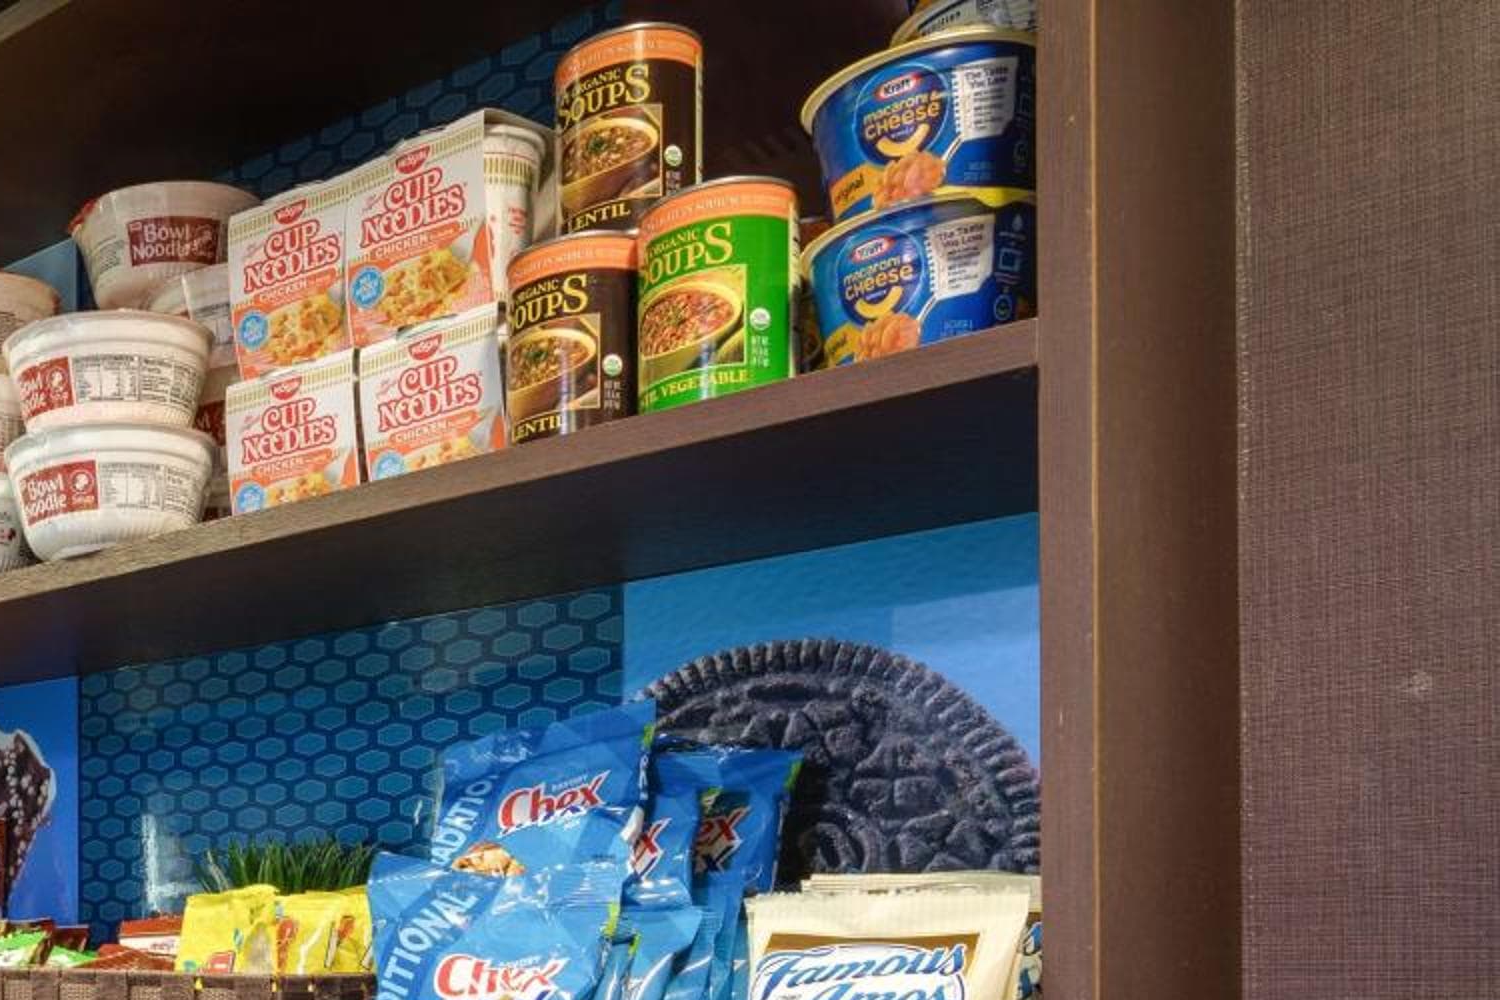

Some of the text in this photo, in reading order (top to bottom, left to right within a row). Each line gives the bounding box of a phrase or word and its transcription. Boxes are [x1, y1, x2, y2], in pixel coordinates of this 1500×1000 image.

[559, 63, 651, 131] SOUPS
[884, 78, 911, 95] Kraft
[863, 94, 929, 126] macaroni
[384, 167, 443, 211] CUP
[143, 223, 191, 243] Bowl
[360, 184, 465, 248] NOODLES
[568, 202, 631, 234] LENTIL
[265, 219, 320, 260] CUP
[243, 234, 340, 294] NOODLES
[399, 356, 458, 397] CUP
[262, 397, 316, 434] CUP
[378, 373, 482, 432] NOODLES
[242, 415, 337, 465] NOODLES
[28, 473, 65, 497] Bowl
[498, 770, 611, 834] Chex
[434, 953, 570, 999] Chex
